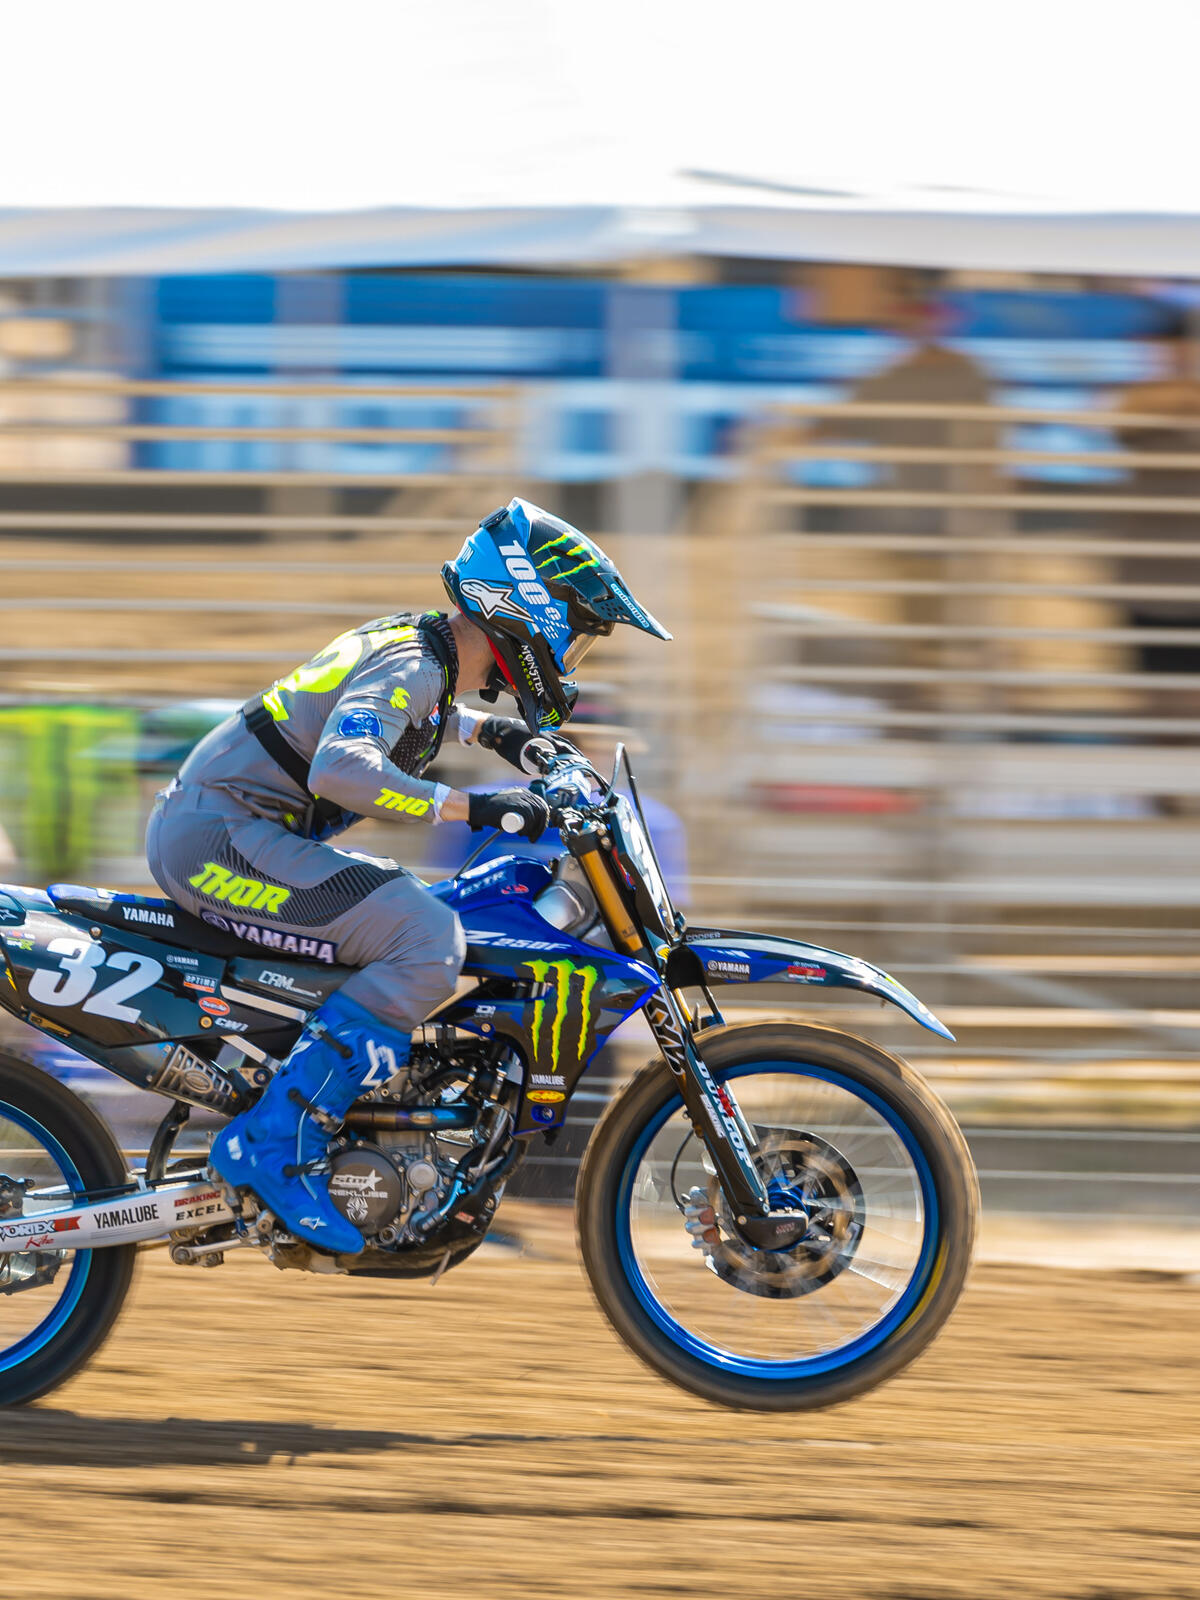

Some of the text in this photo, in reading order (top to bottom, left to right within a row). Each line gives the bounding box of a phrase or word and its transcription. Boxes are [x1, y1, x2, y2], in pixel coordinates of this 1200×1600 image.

[521, 644, 545, 697] MONSTER
[374, 788, 435, 817] THO
[188, 861, 291, 914] THOR
[122, 906, 175, 928] YAMAHA
[230, 921, 336, 964] YAMAHA
[174, 955, 199, 967] YAMAHA
[717, 960, 750, 974] YAMAHA
[28, 938, 164, 1024] 32
[185, 974, 216, 989] OPTIMA
[531, 1074, 566, 1086] YAMALUBE
[695, 1060, 752, 1168] DUNLOP
[94, 1204, 160, 1229] YAMALUBE
[175, 1203, 226, 1221] EXCEL
